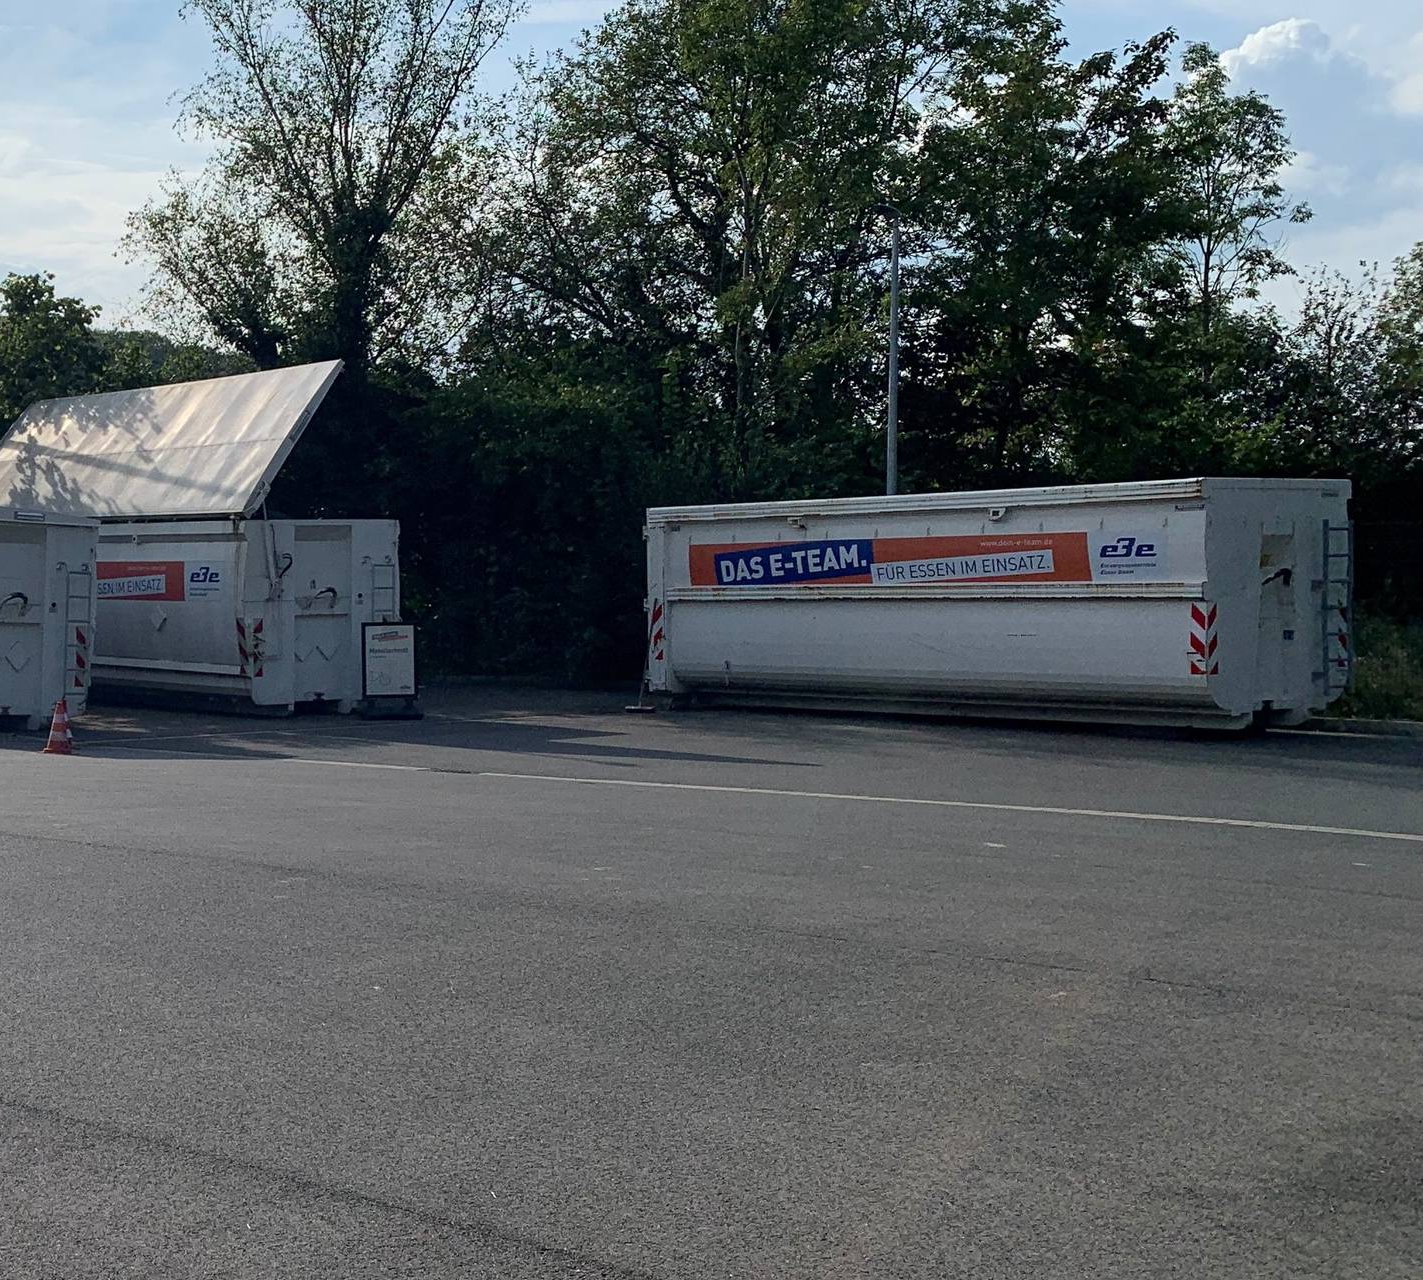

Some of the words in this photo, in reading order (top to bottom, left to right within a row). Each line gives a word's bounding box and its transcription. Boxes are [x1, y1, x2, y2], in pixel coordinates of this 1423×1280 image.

[1099, 537, 1157, 558] e3e
[190, 566, 220, 583] e3e
[720, 556, 765, 583] DAS
[769, 543, 867, 577] E-TEAM.
[877, 564, 906, 581] FÜR
[909, 562, 956, 579] ESSEN
[960, 559, 977, 574] IM
[982, 554, 1050, 574] EINSATZ.
